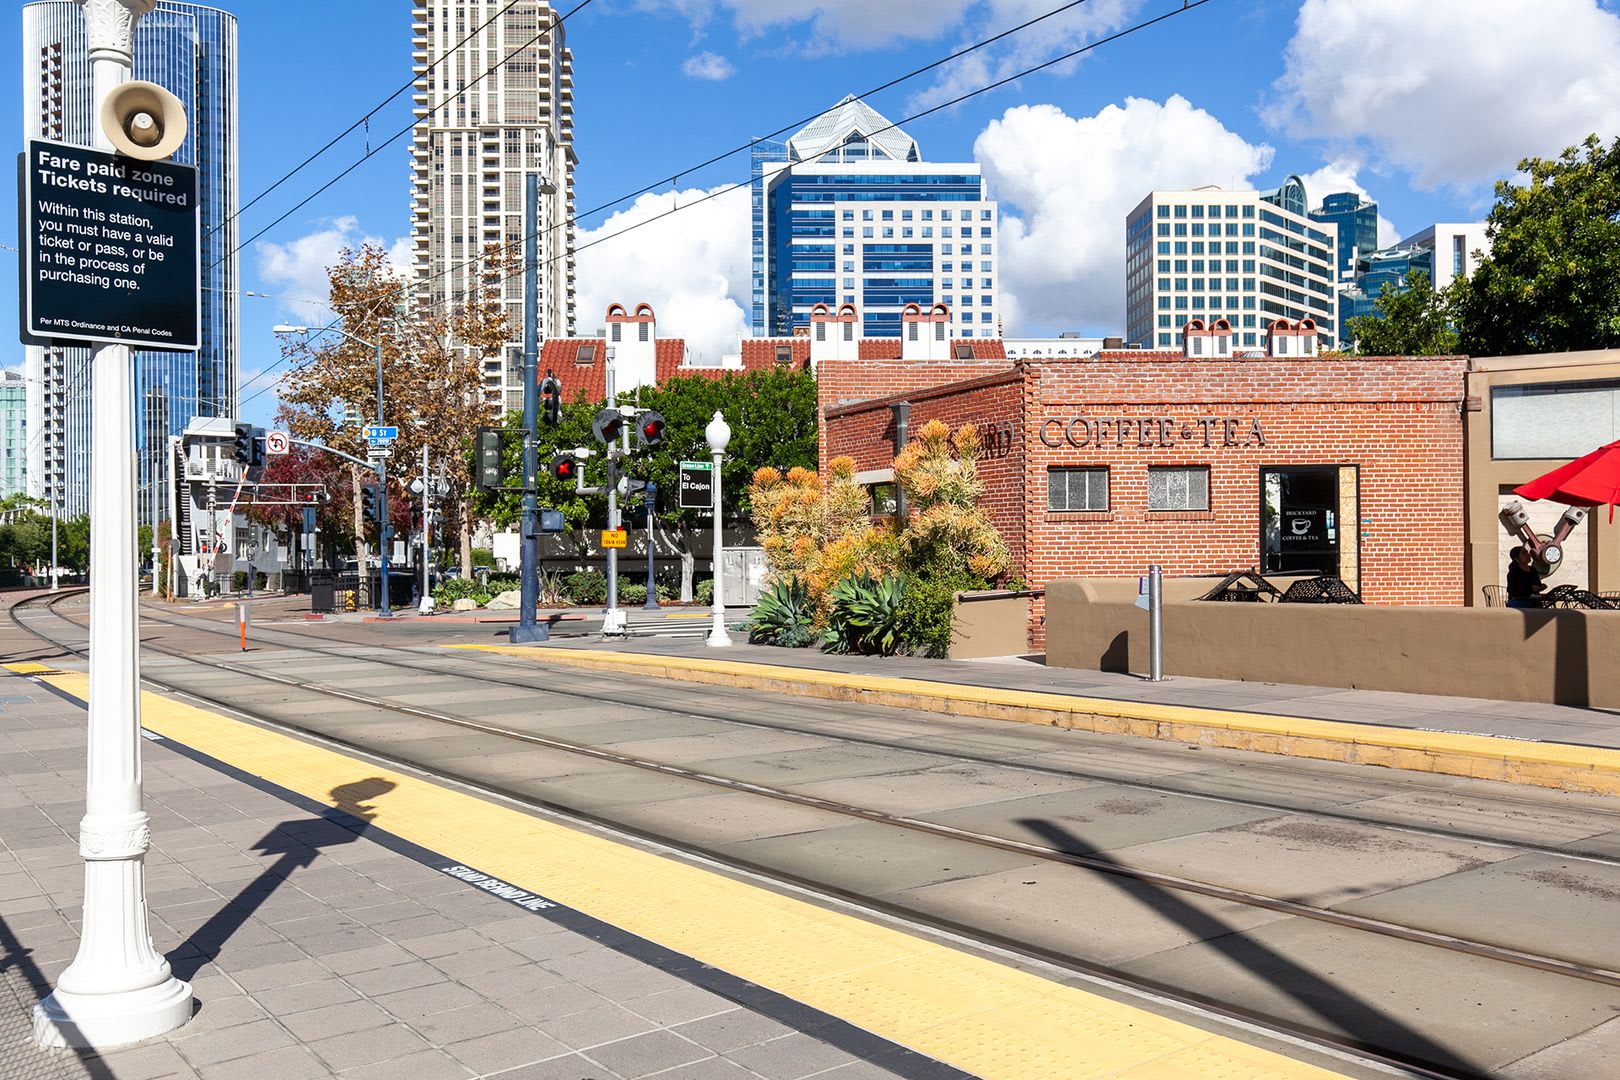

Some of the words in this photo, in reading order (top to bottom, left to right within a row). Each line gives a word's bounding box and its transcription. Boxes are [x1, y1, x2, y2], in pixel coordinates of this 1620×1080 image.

[39, 151, 80, 171] Fare
[87, 162, 126, 178] paid
[132, 170, 174, 186] zone
[38, 169, 107, 193] Tickets
[113, 184, 187, 206] required
[38, 200, 79, 217] Within
[83, 207, 106, 221] this
[109, 212, 153, 230] station,
[38, 219, 63, 232] you
[66, 223, 99, 236] must
[102, 226, 131, 241] have
[134, 233, 143, 243] a
[146, 234, 173, 247] valid
[39, 234, 74, 249] ticket
[78, 241, 91, 251] or
[95, 243, 128, 258] pass,
[132, 248, 145, 258] or
[148, 248, 164, 261] be
[39, 250, 51, 262] in
[55, 252, 75, 265] the
[79, 257, 129, 272] process
[132, 263, 145, 274] of
[39, 269, 110, 288] purchasing
[114, 278, 140, 289] one.
[40, 317, 52, 325] Per
[53, 318, 69, 327] MTS
[71, 320, 106, 331] Ordinance
[106, 324, 119, 332] and
[120, 325, 131, 333] CA
[132, 326, 150, 335] Penal
[151, 328, 173, 337] Codes
[1039, 416, 1176, 448] COFFEE
[1181, 422, 1193, 439] &
[1197, 416, 1267, 448] TEA
[690, 482, 710, 491] Cajon
[473, 879, 529, 899] BEHIND
[512, 895, 557, 911] LINE
